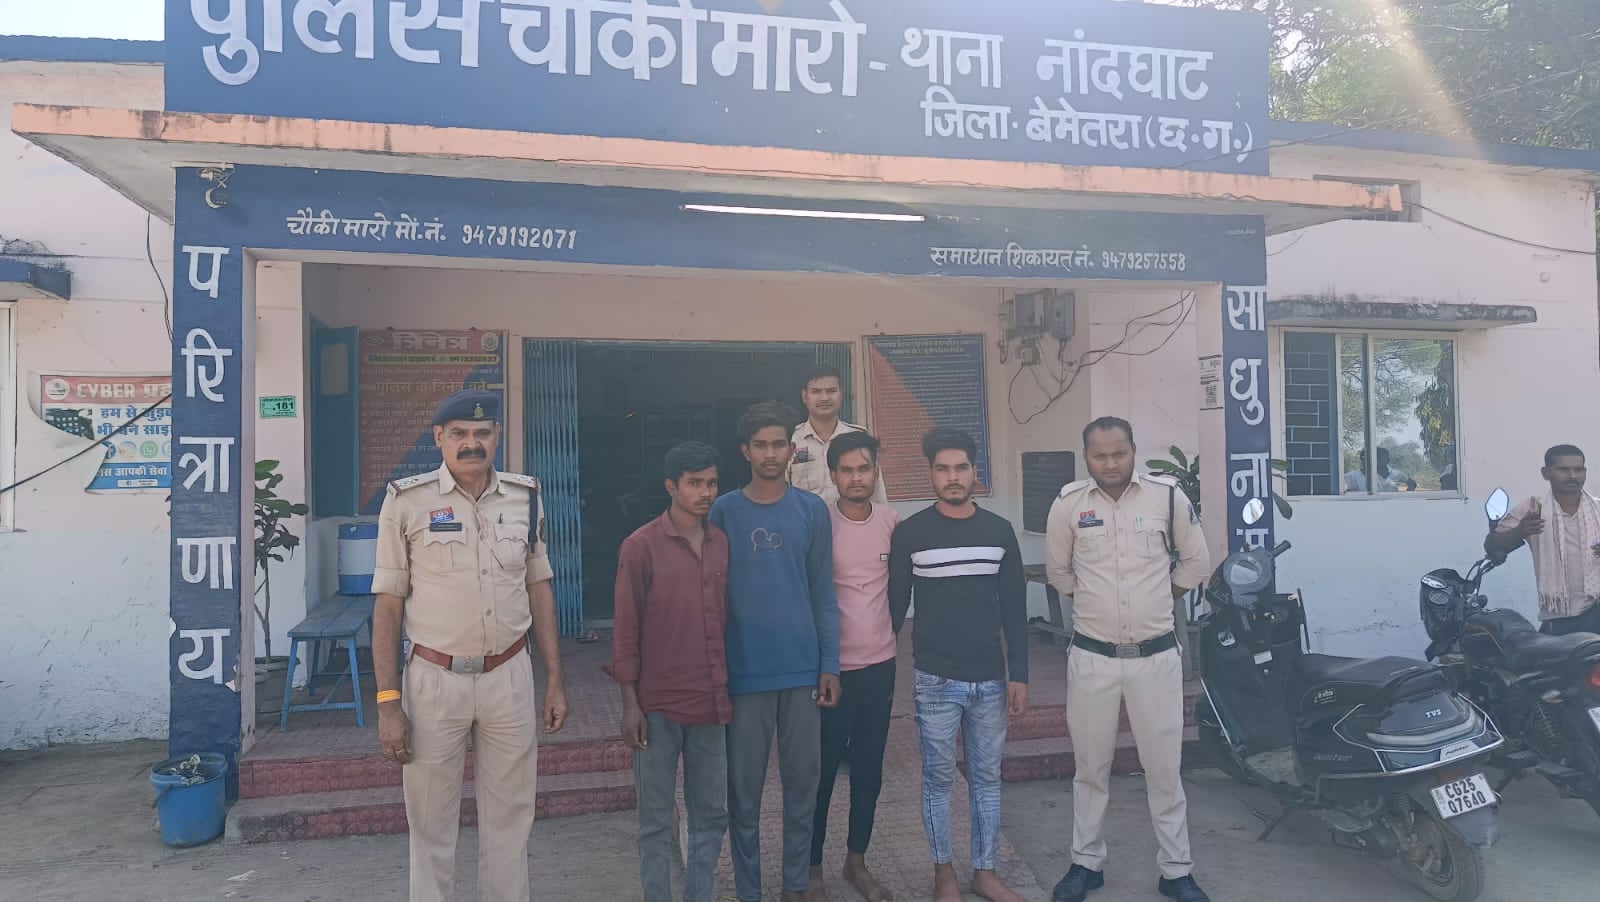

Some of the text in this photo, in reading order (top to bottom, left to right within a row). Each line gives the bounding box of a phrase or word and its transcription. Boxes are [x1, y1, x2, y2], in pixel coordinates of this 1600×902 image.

[901, 27, 1002, 89] थाना
[1036, 28, 1214, 101] नांदघाट
[286, 207, 340, 236] चौकी
[341, 212, 391, 241] मारो
[462, 224, 577, 250] 9479192071
[929, 246, 1004, 267] समाधान
[1101, 250, 1187, 272] 9479257558
[77, 383, 136, 398] CYBER
[1424, 708, 1441, 719] TVS
[1445, 777, 1476, 798] CG25
